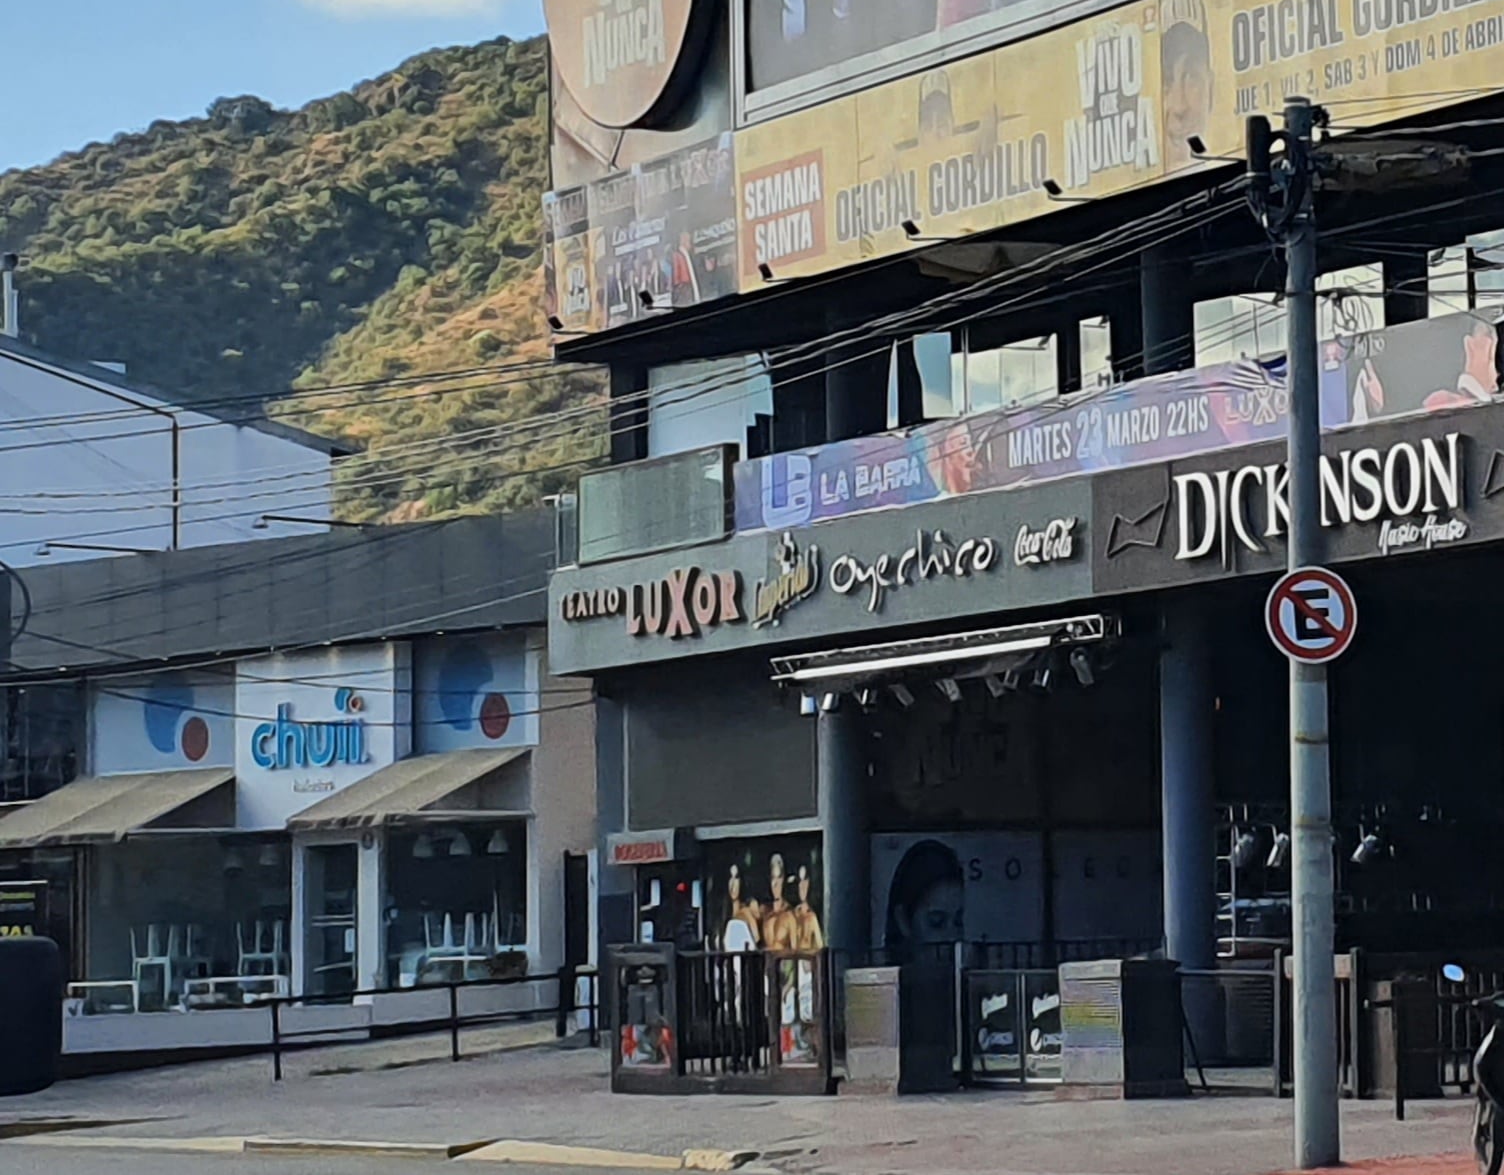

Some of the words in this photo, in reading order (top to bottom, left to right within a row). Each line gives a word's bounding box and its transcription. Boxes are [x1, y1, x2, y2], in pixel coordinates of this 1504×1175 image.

[1075, 23, 1144, 111] VIVO
[1234, 86, 1260, 116] JUE
[1324, 58, 1353, 91] SAB
[1357, 54, 1367, 82] 3
[1370, 48, 1380, 75] Y
[1384, 37, 1422, 74] DOM
[1426, 33, 1436, 62] 4
[1441, 27, 1460, 59] DE
[834, 168, 922, 243] OFICIAL
[927, 132, 1048, 217] GORDILLO
[1064, 96, 1159, 190] NUNCA
[743, 160, 821, 221] SEMANA
[754, 212, 815, 264] SANTA
[817, 468, 849, 508] LA
[852, 454, 922, 500] BARRA
[1007, 421, 1073, 469] MARTES
[1106, 408, 1160, 448] MARZO
[1166, 396, 1210, 439] 22HS
[1224, 386, 1289, 425] LUXO
[1172, 432, 1460, 571] DICKNSON
[625, 567, 741, 638] LUXOR
